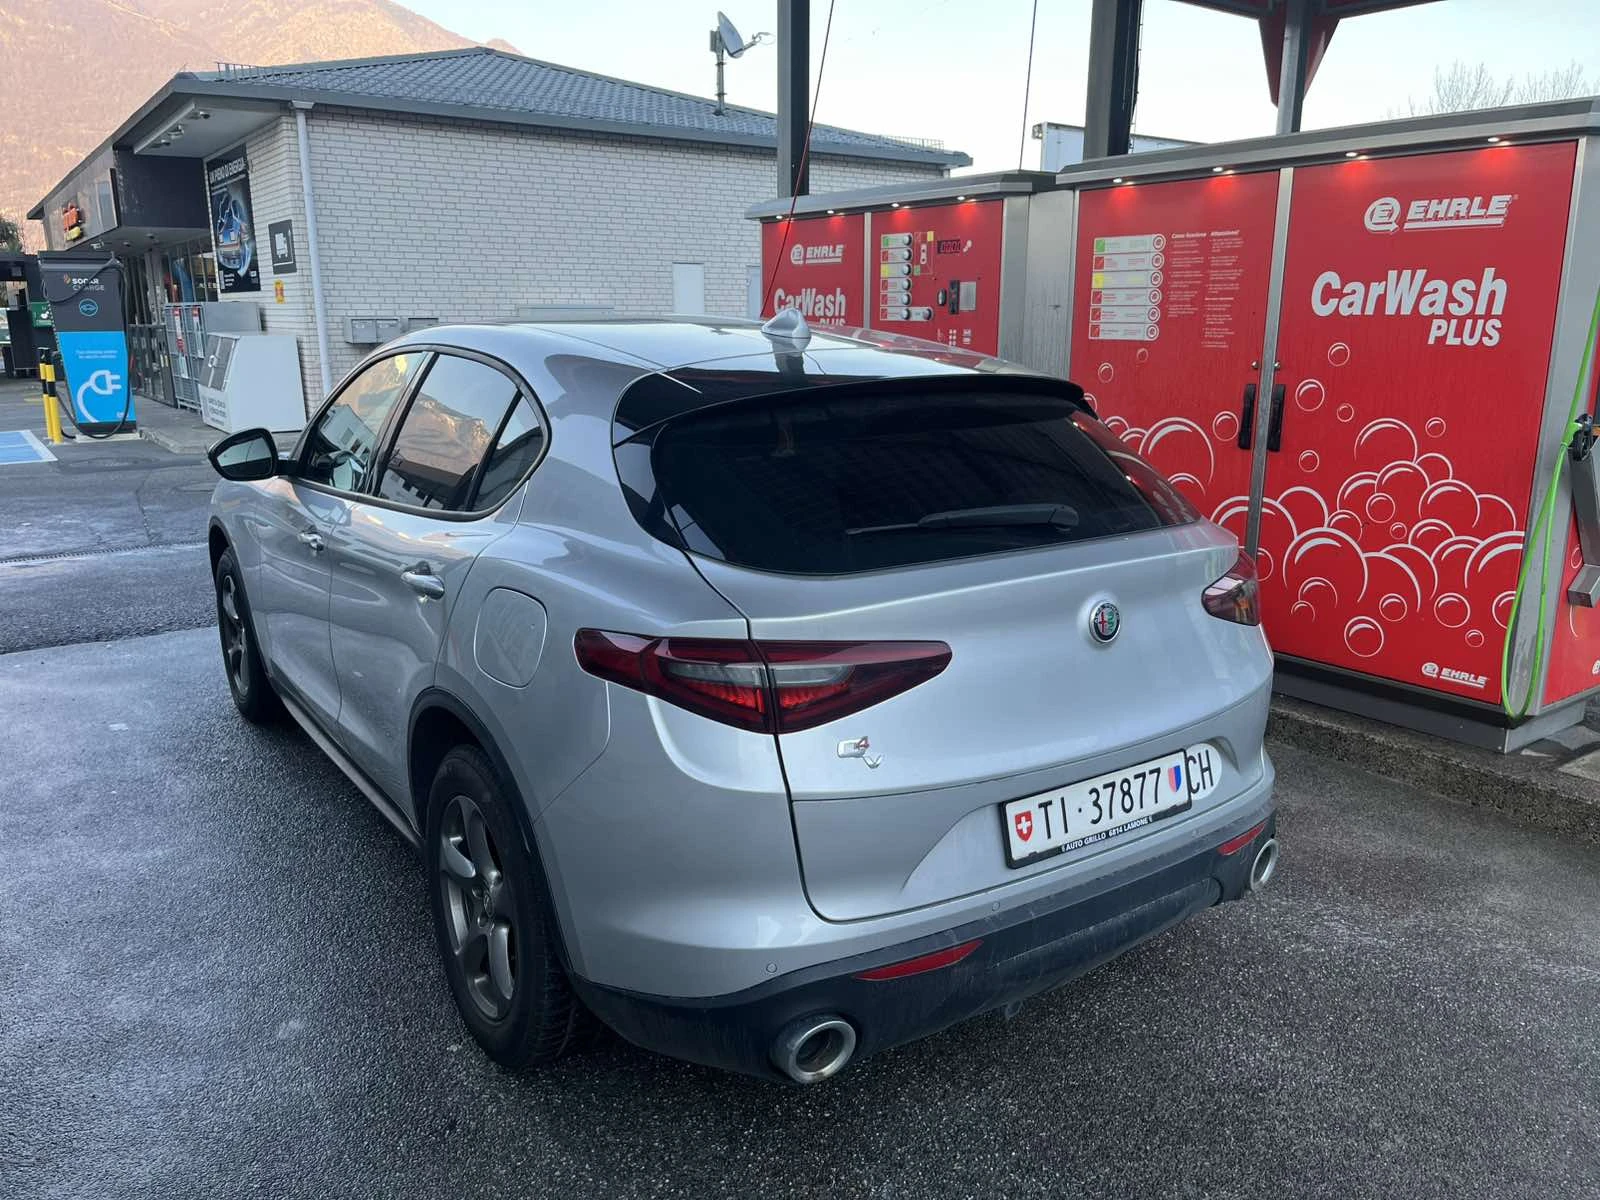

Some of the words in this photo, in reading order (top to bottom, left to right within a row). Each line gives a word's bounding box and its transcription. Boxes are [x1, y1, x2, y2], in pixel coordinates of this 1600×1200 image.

[1406, 194, 1512, 220] EHRLE
[806, 244, 844, 259] EHRLE
[1311, 267, 1508, 317] CarWash
[1427, 319, 1502, 347] PLUS
[1441, 667, 1488, 686] EHRLE
[1185, 749, 1214, 794] CH
[1038, 796, 1069, 839] TI
[1088, 767, 1162, 825] 37877
[1066, 840, 1083, 851] AUTO
[1084, 832, 1106, 845] GRILLO
[1109, 827, 1122, 837] 6814
[1123, 818, 1149, 832] LAMONE
